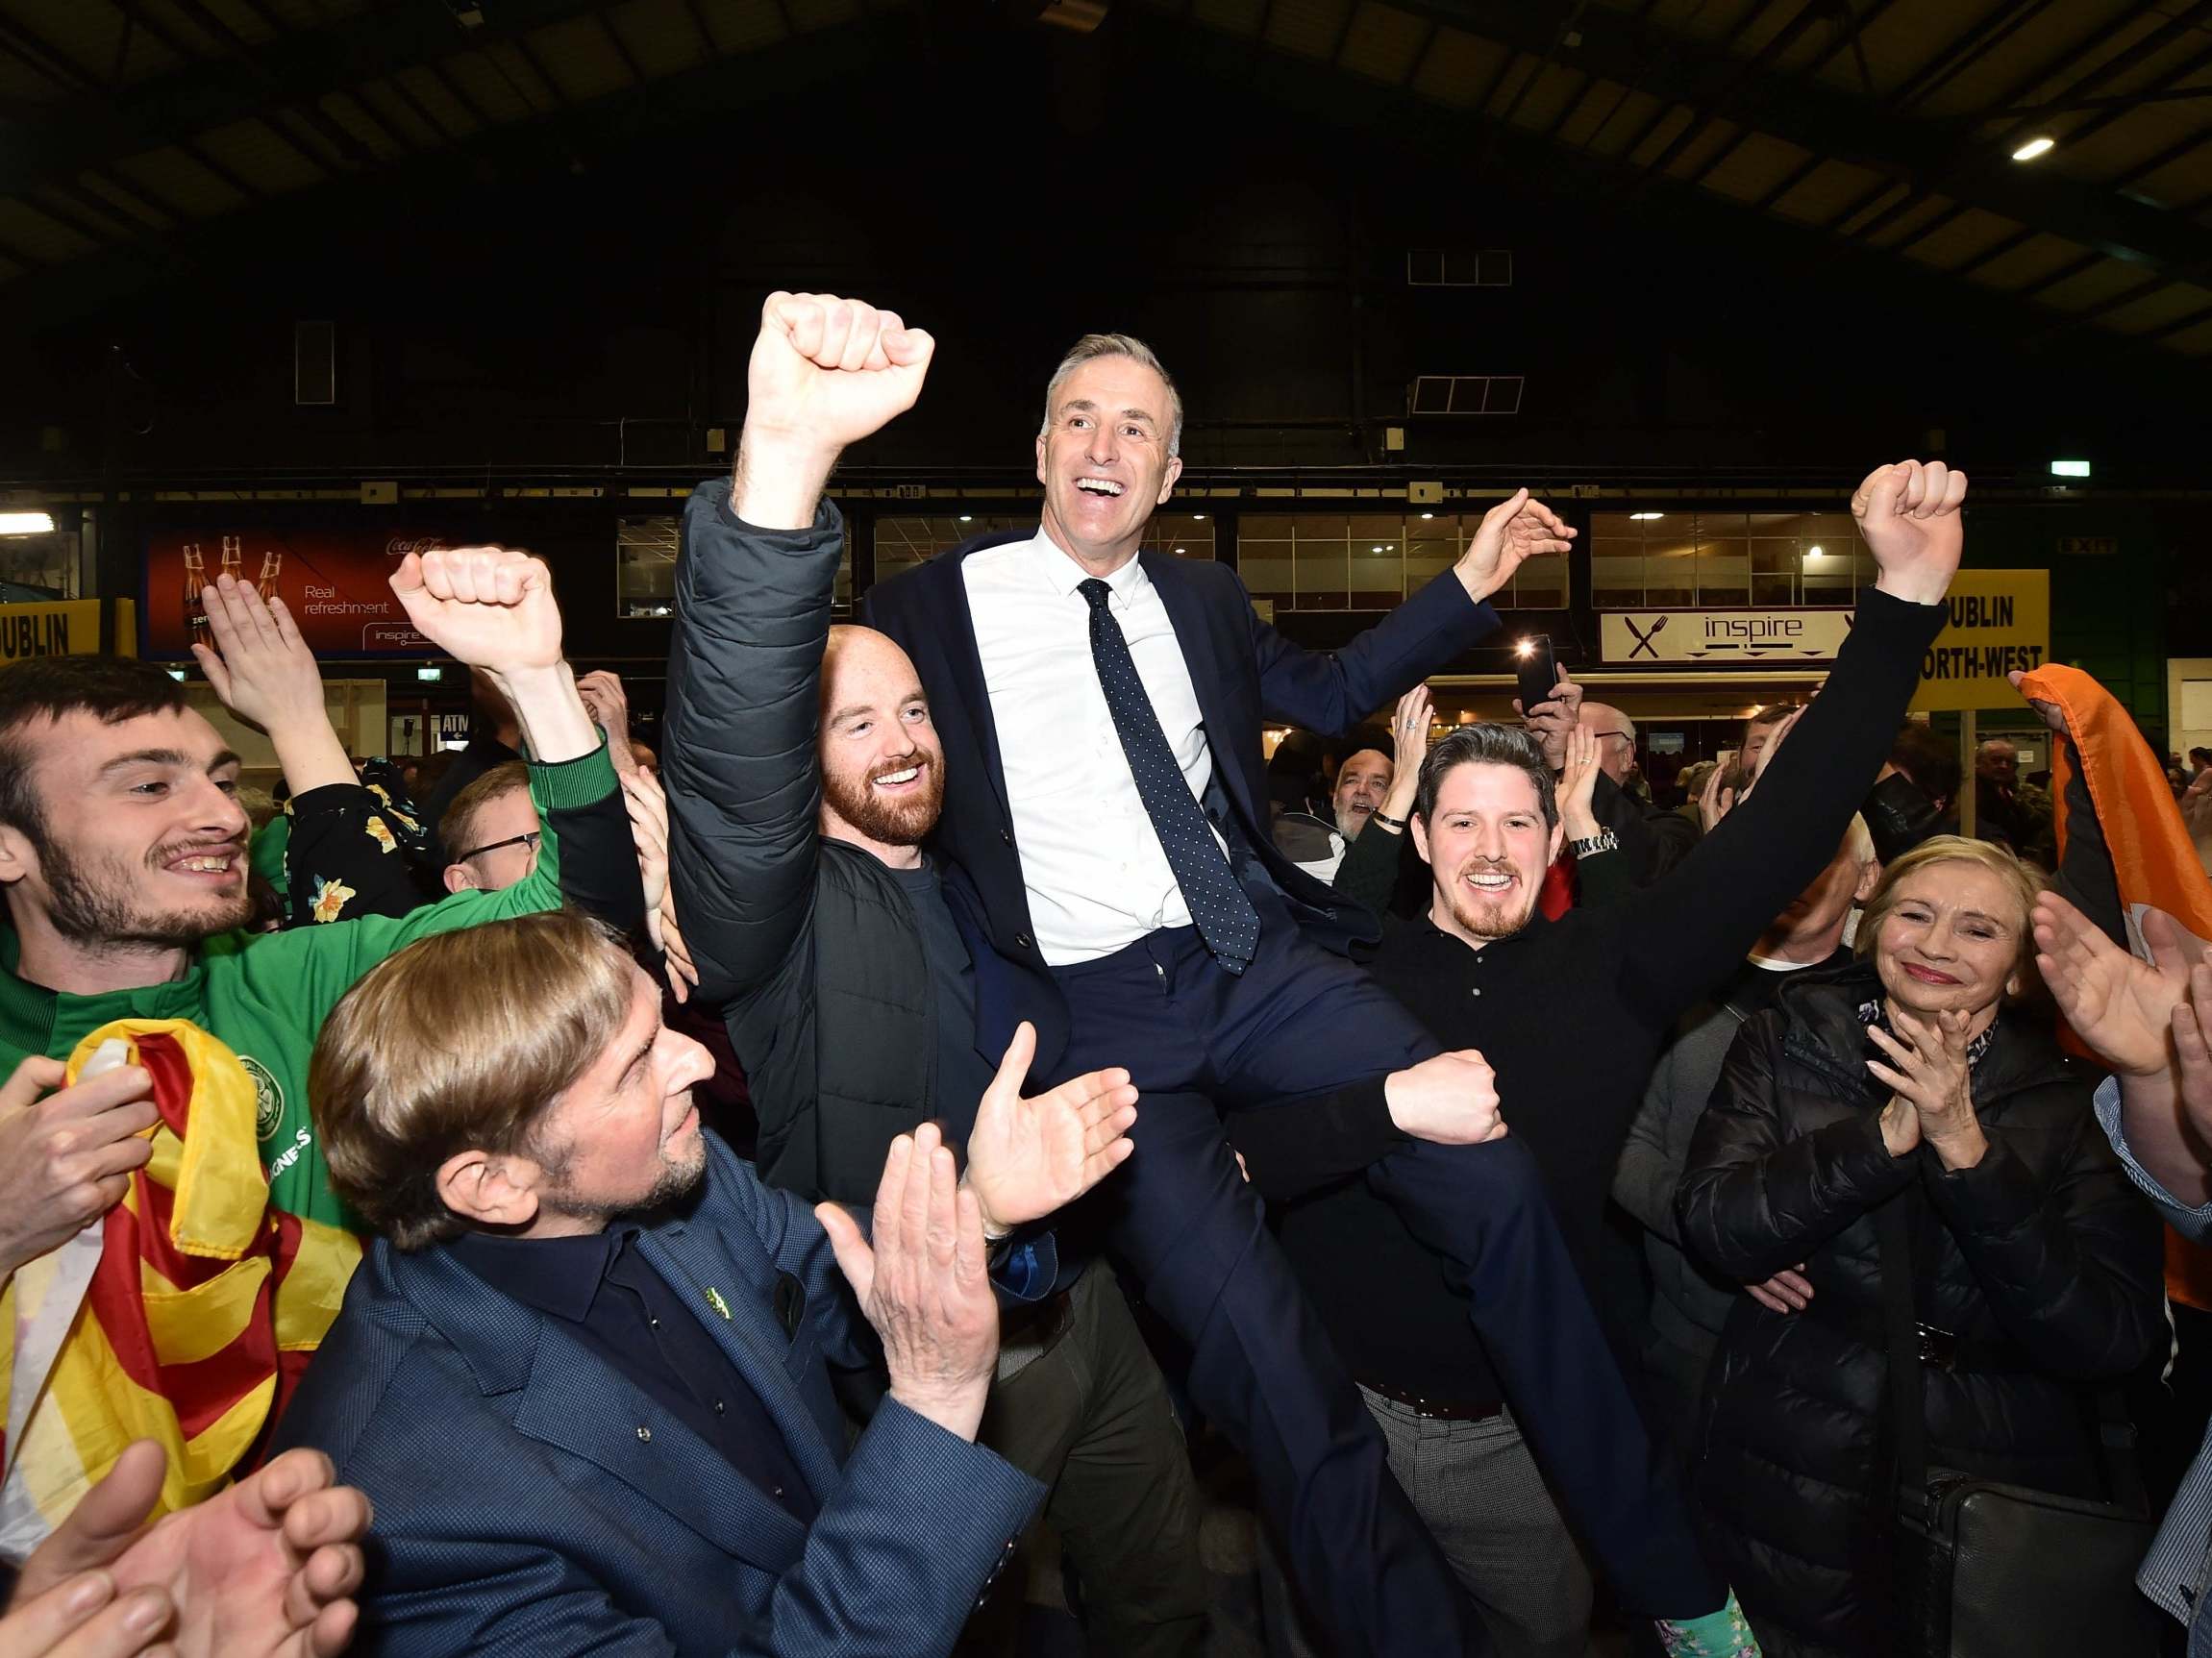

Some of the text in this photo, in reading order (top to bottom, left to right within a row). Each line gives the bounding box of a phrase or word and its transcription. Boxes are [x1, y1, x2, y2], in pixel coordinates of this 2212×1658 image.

[305, 585, 335, 599] Real
[305, 602, 389, 614] refreshment
[1941, 596, 2013, 628] UBLIN
[192, 615, 209, 625] zer
[1704, 616, 1803, 642] inspire
[0, 613, 68, 658] UBLIN
[375, 630, 420, 643] inspire
[1923, 646, 2042, 680] ORTH-WEST
